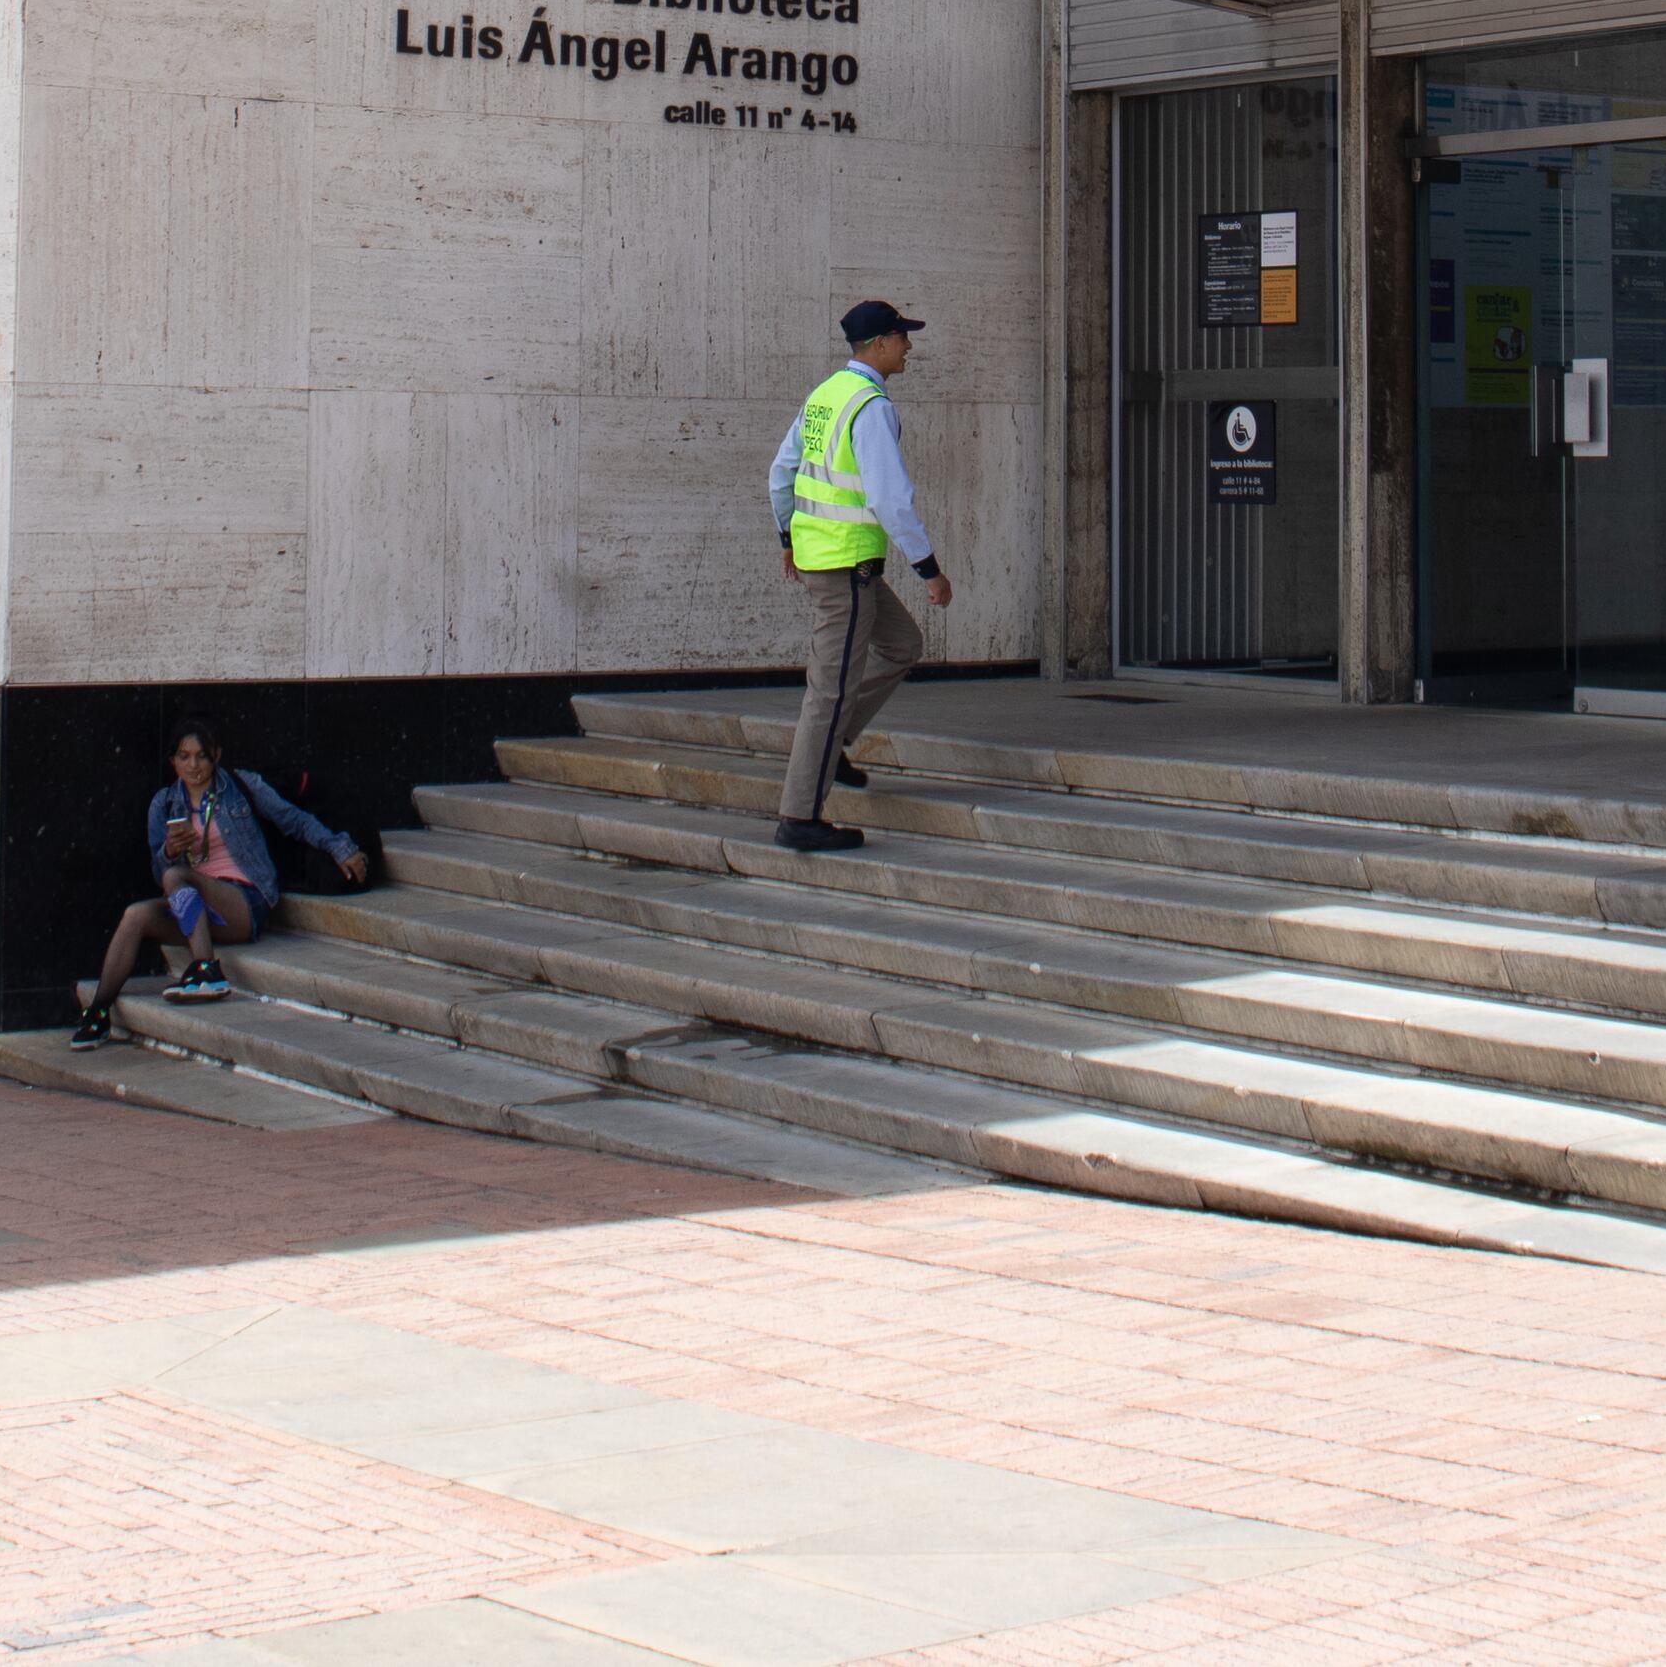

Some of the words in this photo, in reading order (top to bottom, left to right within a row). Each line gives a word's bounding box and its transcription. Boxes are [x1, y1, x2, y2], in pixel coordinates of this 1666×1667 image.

[395, 8, 503, 60] Luis
[518, 6, 667, 81] Ángel
[682, 32, 859, 96] Arango
[664, 100, 726, 127] calle
[737, 105, 758, 129] 11
[801, 109, 857, 135] 4-14
[1217, 221, 1242, 231] Horario
[1210, 459, 1232, 470] Ingreso
